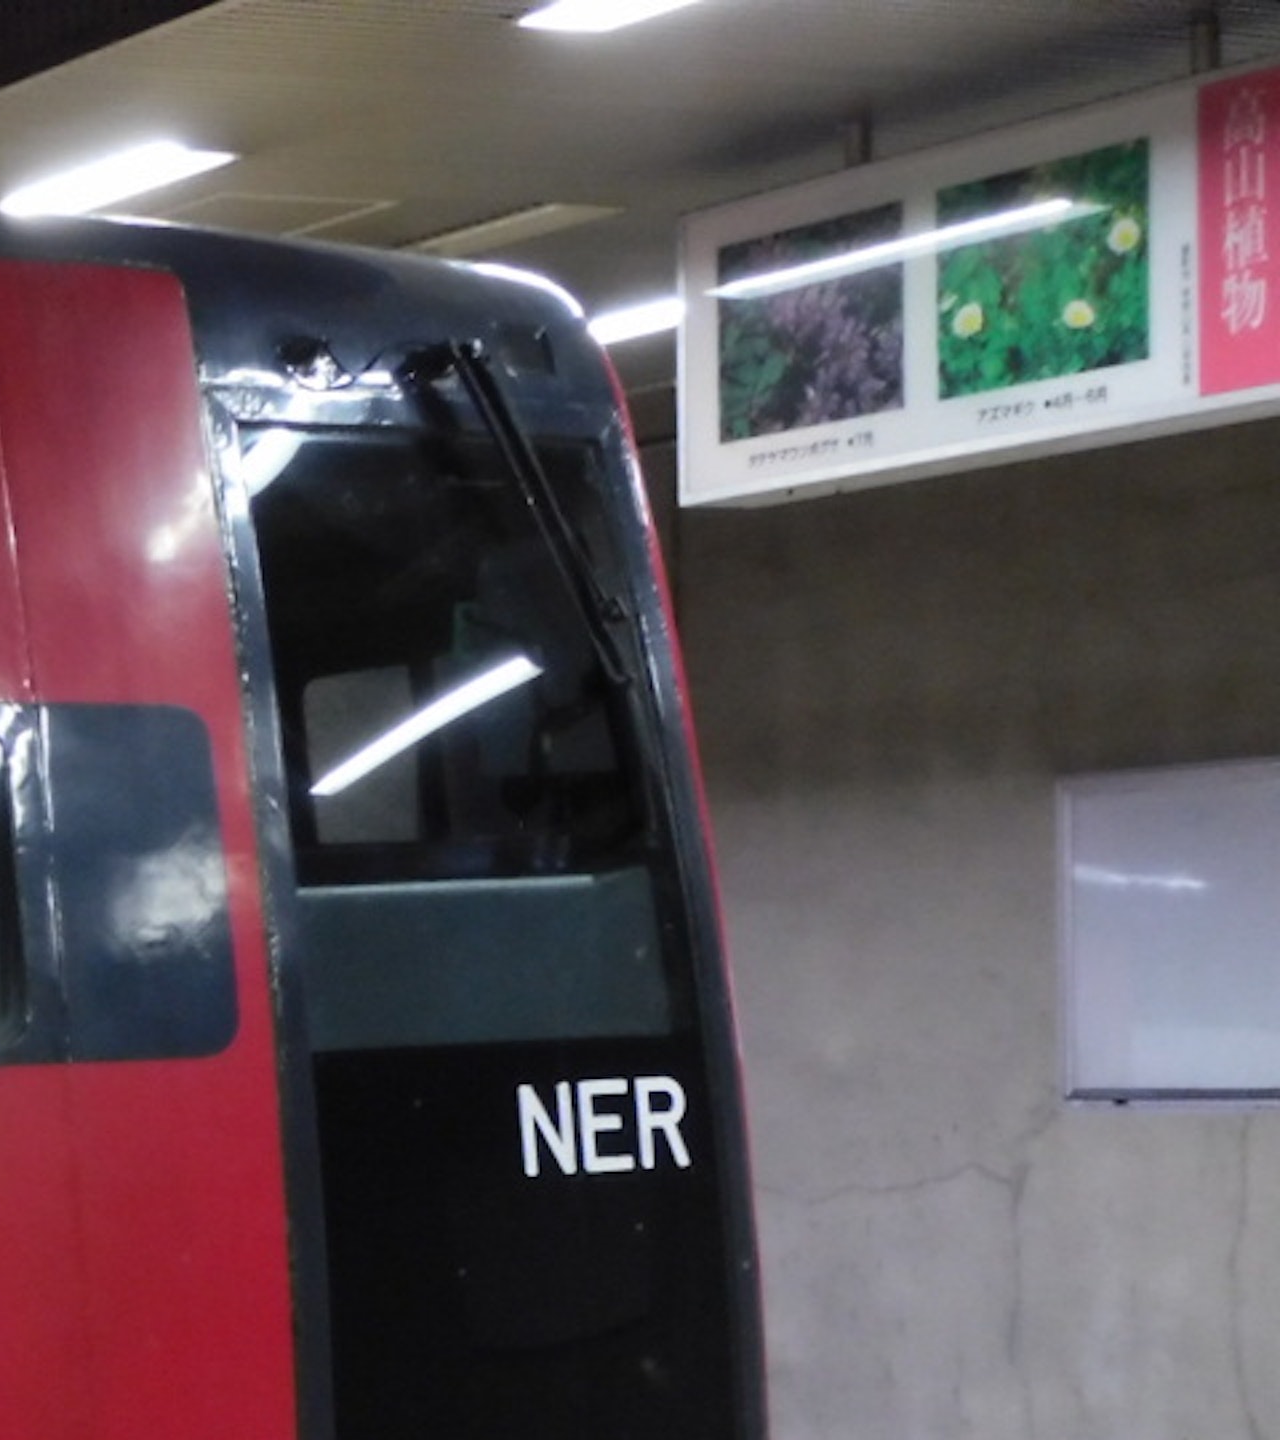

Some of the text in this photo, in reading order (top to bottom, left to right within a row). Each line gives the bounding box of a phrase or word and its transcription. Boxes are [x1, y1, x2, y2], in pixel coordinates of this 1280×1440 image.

[1222, 89, 1269, 336] 高山植物
[517, 1075, 691, 1178] NER
